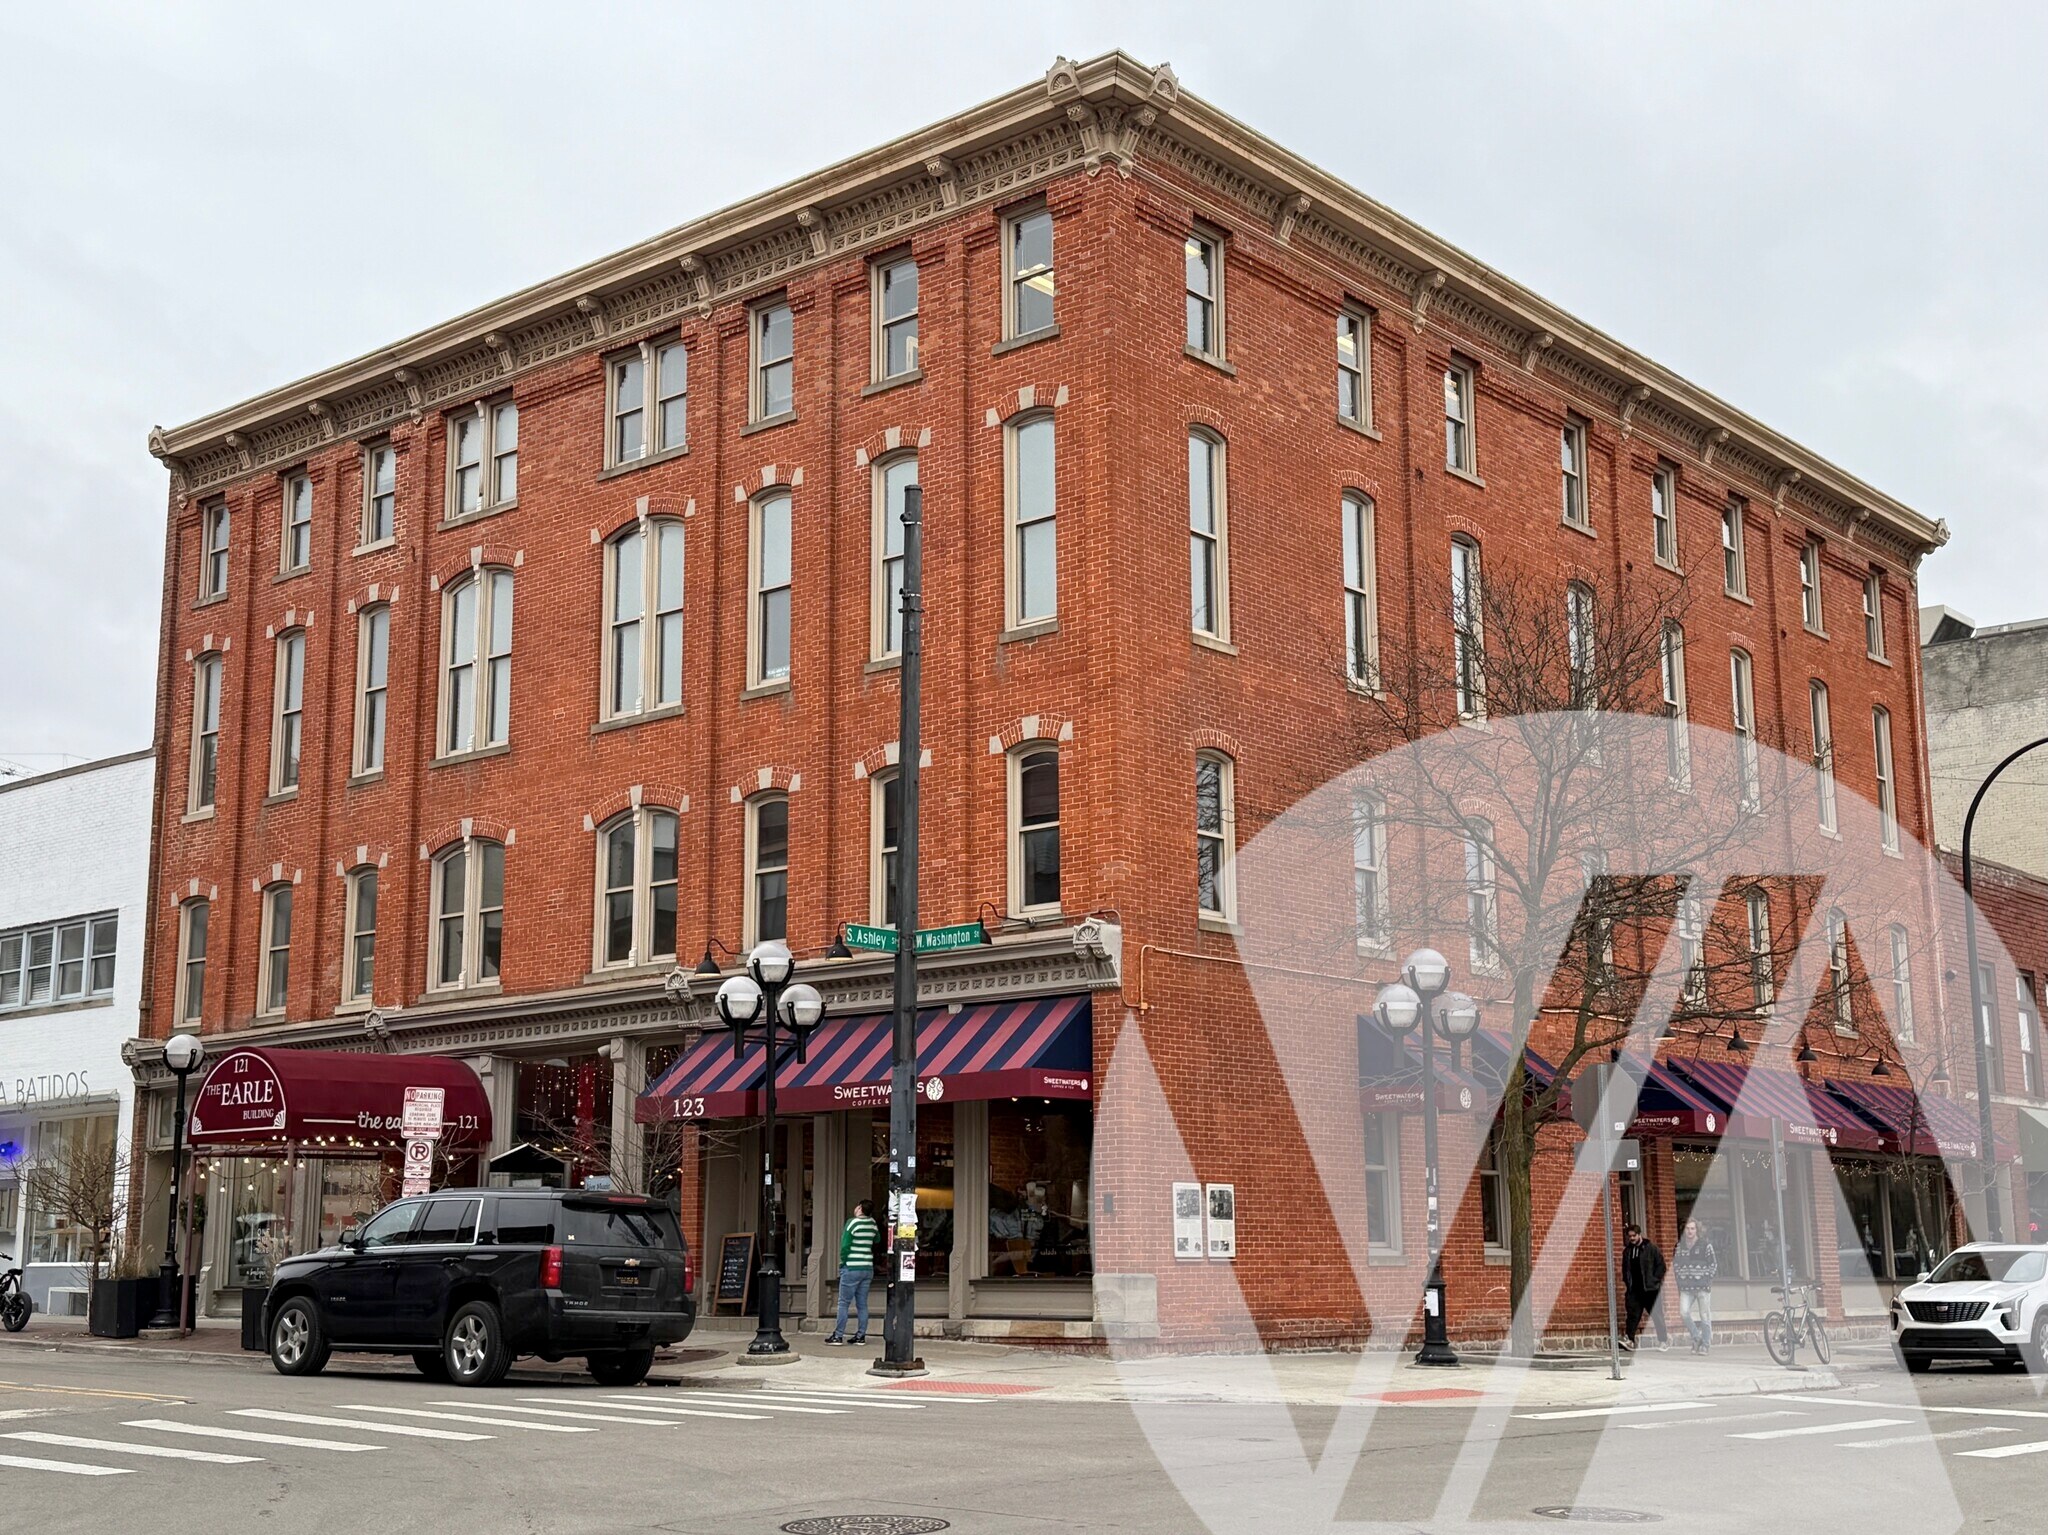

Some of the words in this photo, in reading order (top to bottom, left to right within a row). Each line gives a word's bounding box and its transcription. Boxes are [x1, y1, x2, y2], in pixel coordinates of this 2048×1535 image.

[846, 928, 855, 943] S.
[856, 929, 887, 949] Ashley
[915, 934, 925, 948] W.
[926, 930, 971, 948] Washington
[233, 1058, 249, 1074] 121
[16, 1070, 89, 1105] BATIDOS
[1043, 1076, 1081, 1086] SWEETWATERS
[206, 1084, 221, 1096] THE
[220, 1079, 274, 1106] EARLE
[406, 1090, 416, 1101] NO
[416, 1091, 442, 1101] PARKING
[834, 1081, 925, 1100] SWEETWAS
[1374, 1092, 1420, 1101] SWEETWATERS
[672, 1097, 705, 1118] 123
[851, 1098, 882, 1107] COFFEE
[242, 1108, 275, 1120] BUILDING
[358, 1111, 382, 1130] the
[458, 1115, 479, 1129] 121
[1789, 1122, 1829, 1138] SWEETWATERS
